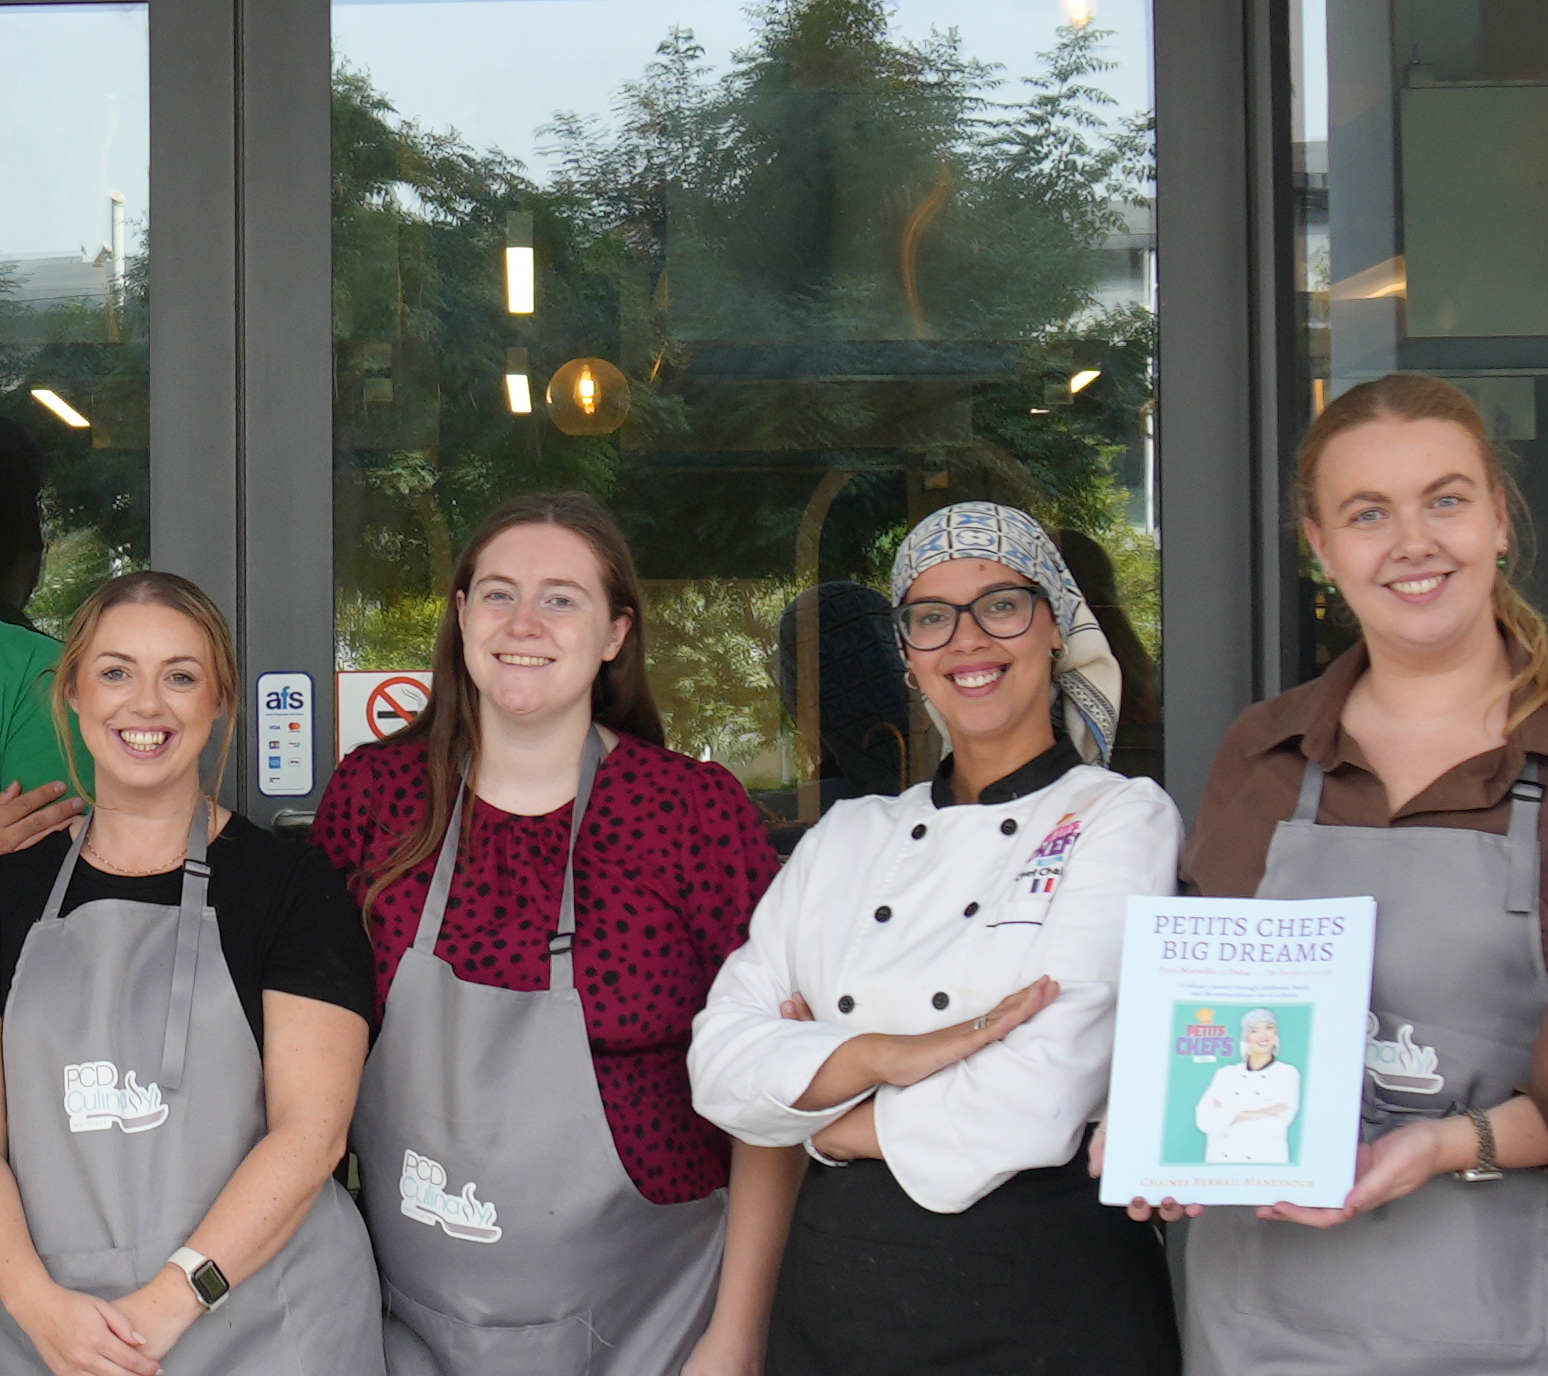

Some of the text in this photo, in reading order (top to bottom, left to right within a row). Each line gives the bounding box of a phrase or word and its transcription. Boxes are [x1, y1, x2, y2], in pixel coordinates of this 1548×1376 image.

[266, 685, 304, 710] afs
[1153, 914, 1346, 938] PETITS CHEFS
[1161, 940, 1334, 963] BIG DREAMS
[1176, 1036, 1234, 1057] CHEFS
[67, 1064, 116, 1091] PCD
[405, 1152, 445, 1187] PCD
